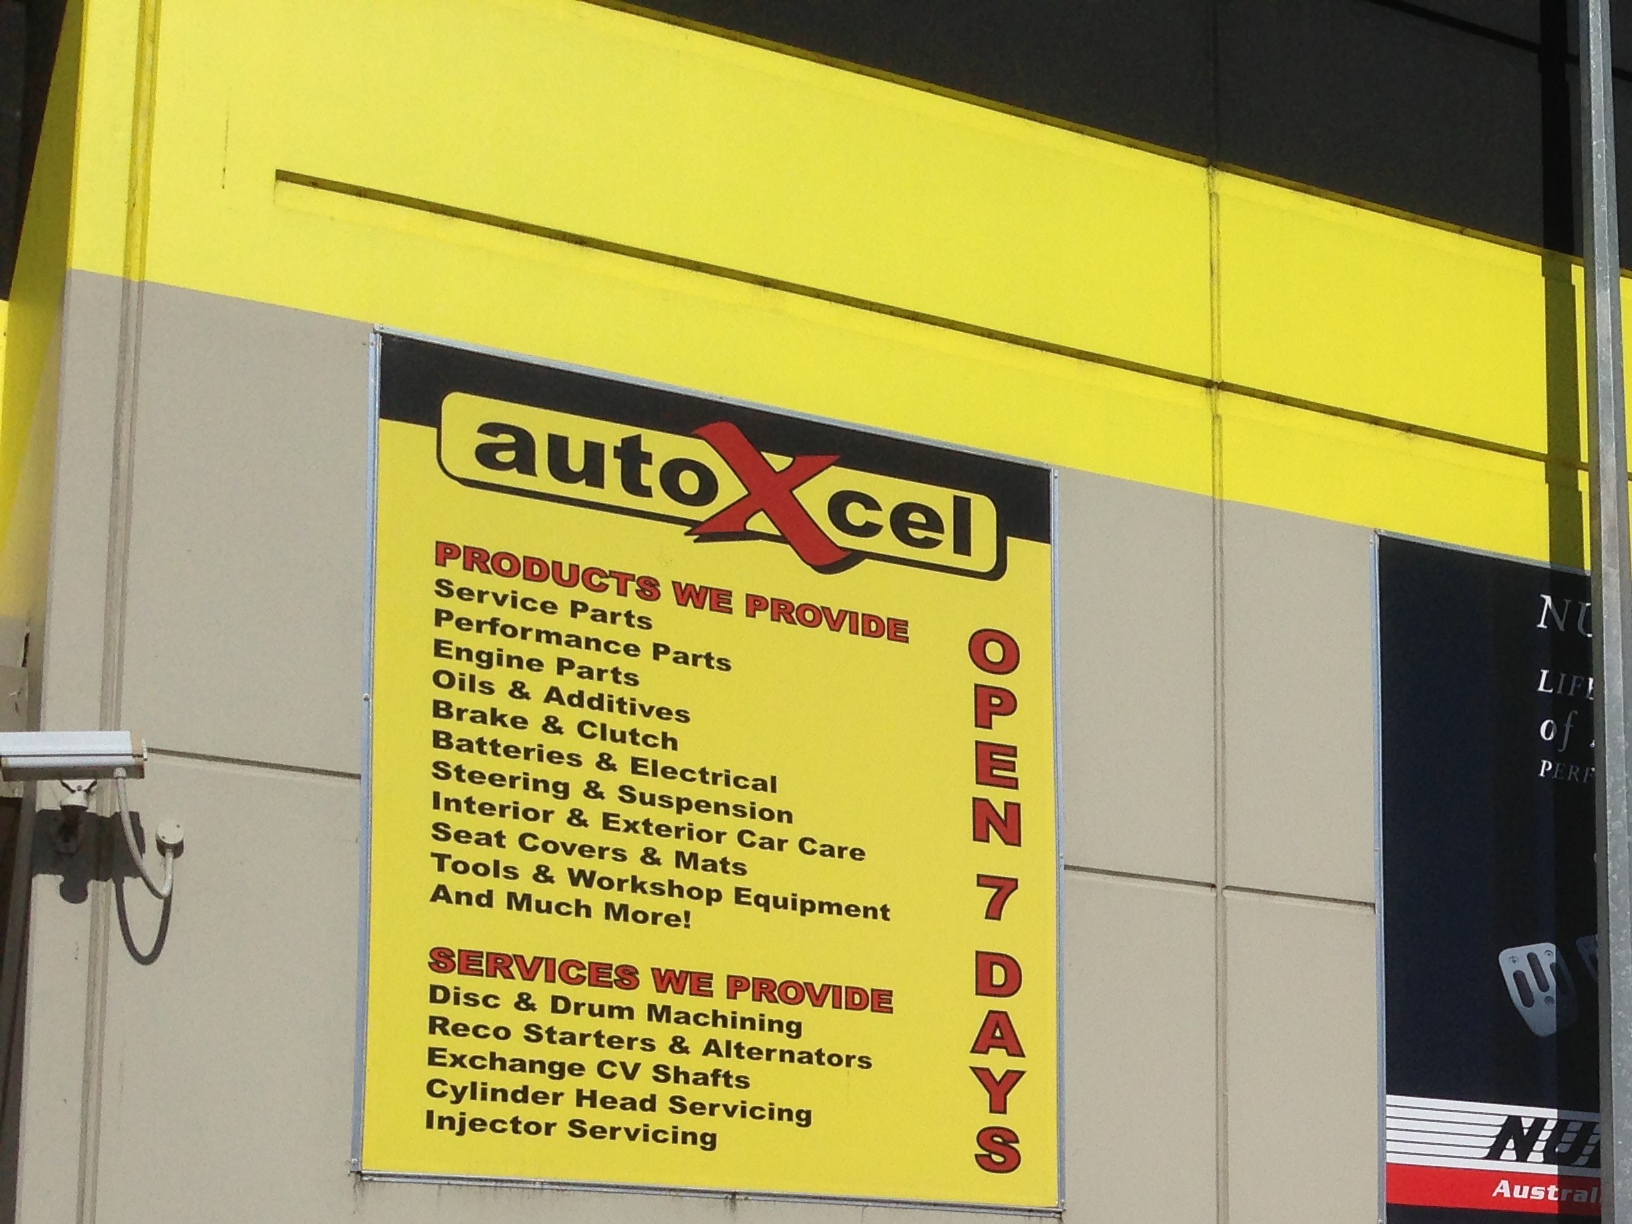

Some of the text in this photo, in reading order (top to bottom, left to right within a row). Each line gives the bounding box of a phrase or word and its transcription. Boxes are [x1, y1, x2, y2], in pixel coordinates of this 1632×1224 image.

[474, 417, 972, 567] autoXcel
[434, 541, 910, 643] PRODUCTS WE PROVIDE
[434, 578, 653, 631] Service Parts
[433, 640, 640, 687] Engine Parts
[434, 609, 733, 672] Performance Parts
[432, 670, 691, 724] Oils & Additives
[432, 700, 679, 752] Brake & Clutch
[432, 730, 778, 794] Batteries & Electrical
[431, 761, 793, 826] Steering & Suspension
[431, 822, 748, 877] Seat Covers & Mats
[432, 791, 866, 863] Interior & Exterior Car Care
[430, 884, 692, 930] And Much More!
[431, 852, 891, 923] Tools & Workshop Equipment
[968, 628, 1026, 1174] OPEN 7 DAYS
[428, 946, 894, 1014] SERVICES WE PROVIDE
[428, 985, 803, 1039] Disc & Drum Machining
[427, 1046, 750, 1090] Exchange CV Shafts
[428, 1015, 872, 1071] Reco Starters & Alternators
[426, 1078, 813, 1128] Cylinder Head Servicing
[425, 1110, 718, 1152] Injector Servicing
